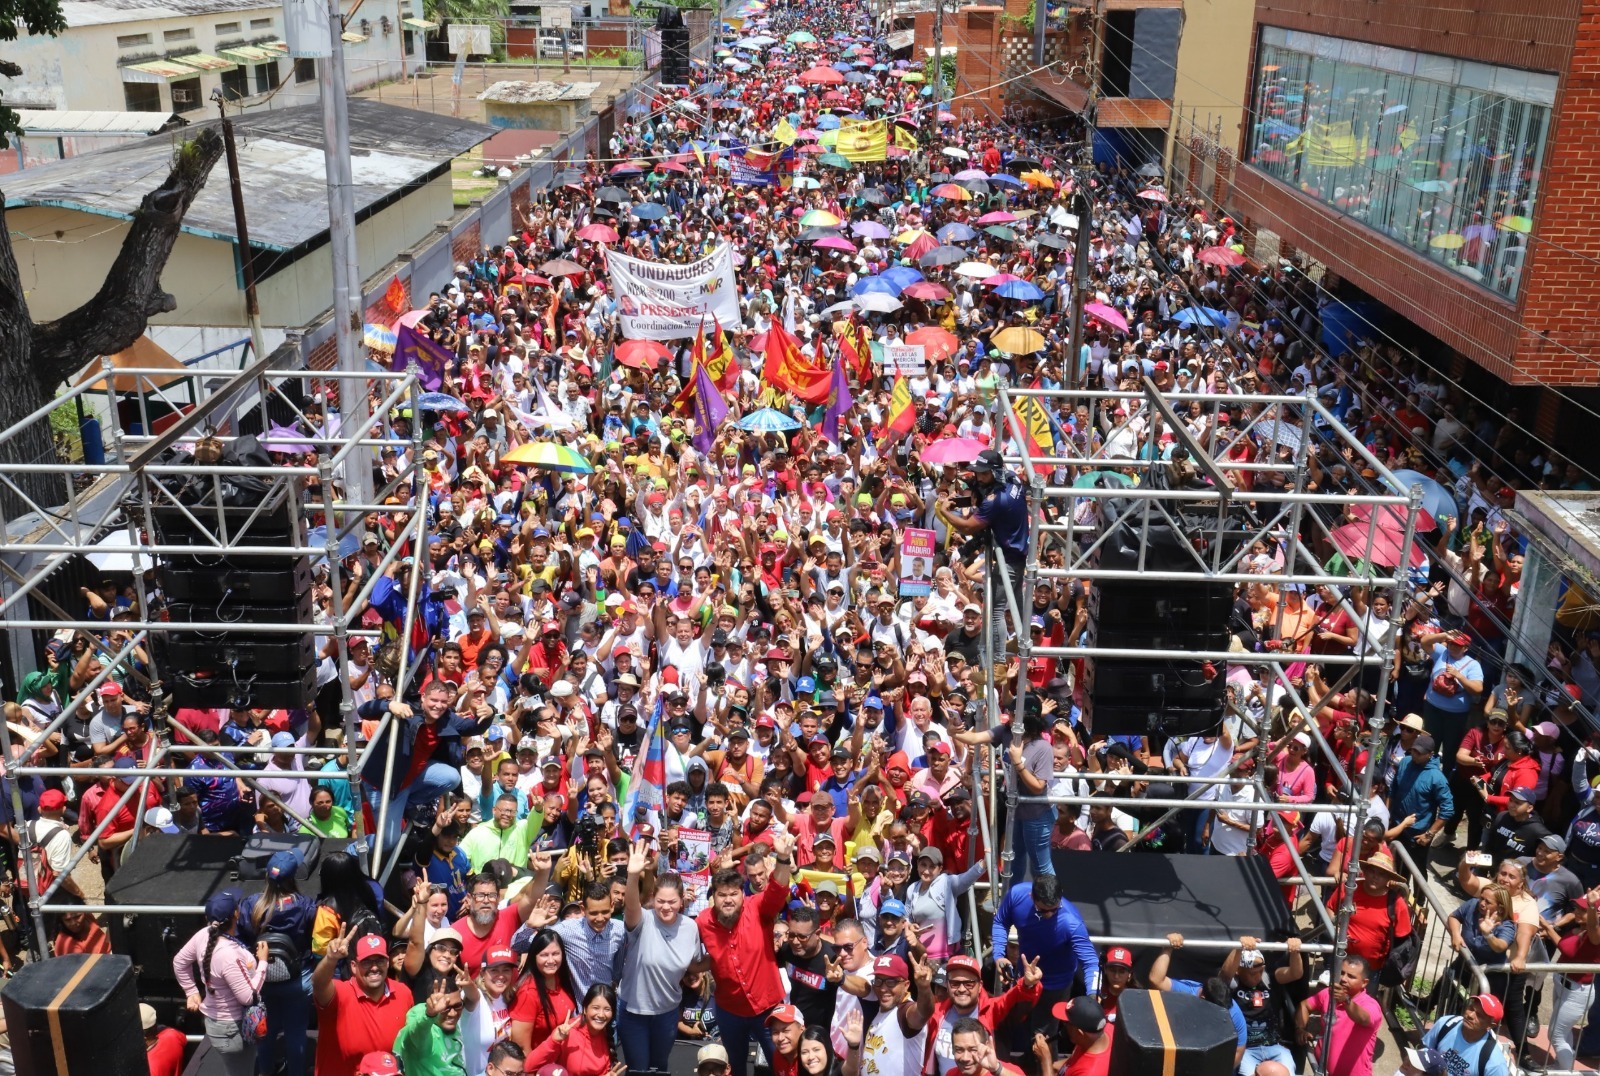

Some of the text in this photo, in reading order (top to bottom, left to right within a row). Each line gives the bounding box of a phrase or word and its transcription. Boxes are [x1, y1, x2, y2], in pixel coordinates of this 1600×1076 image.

[628, 256, 715, 281] FUNDADORES
[657, 288, 675, 301] 200
[700, 277, 723, 295] MVR
[906, 545, 931, 555] MADURO
[1496, 826, 1516, 839] JUST
